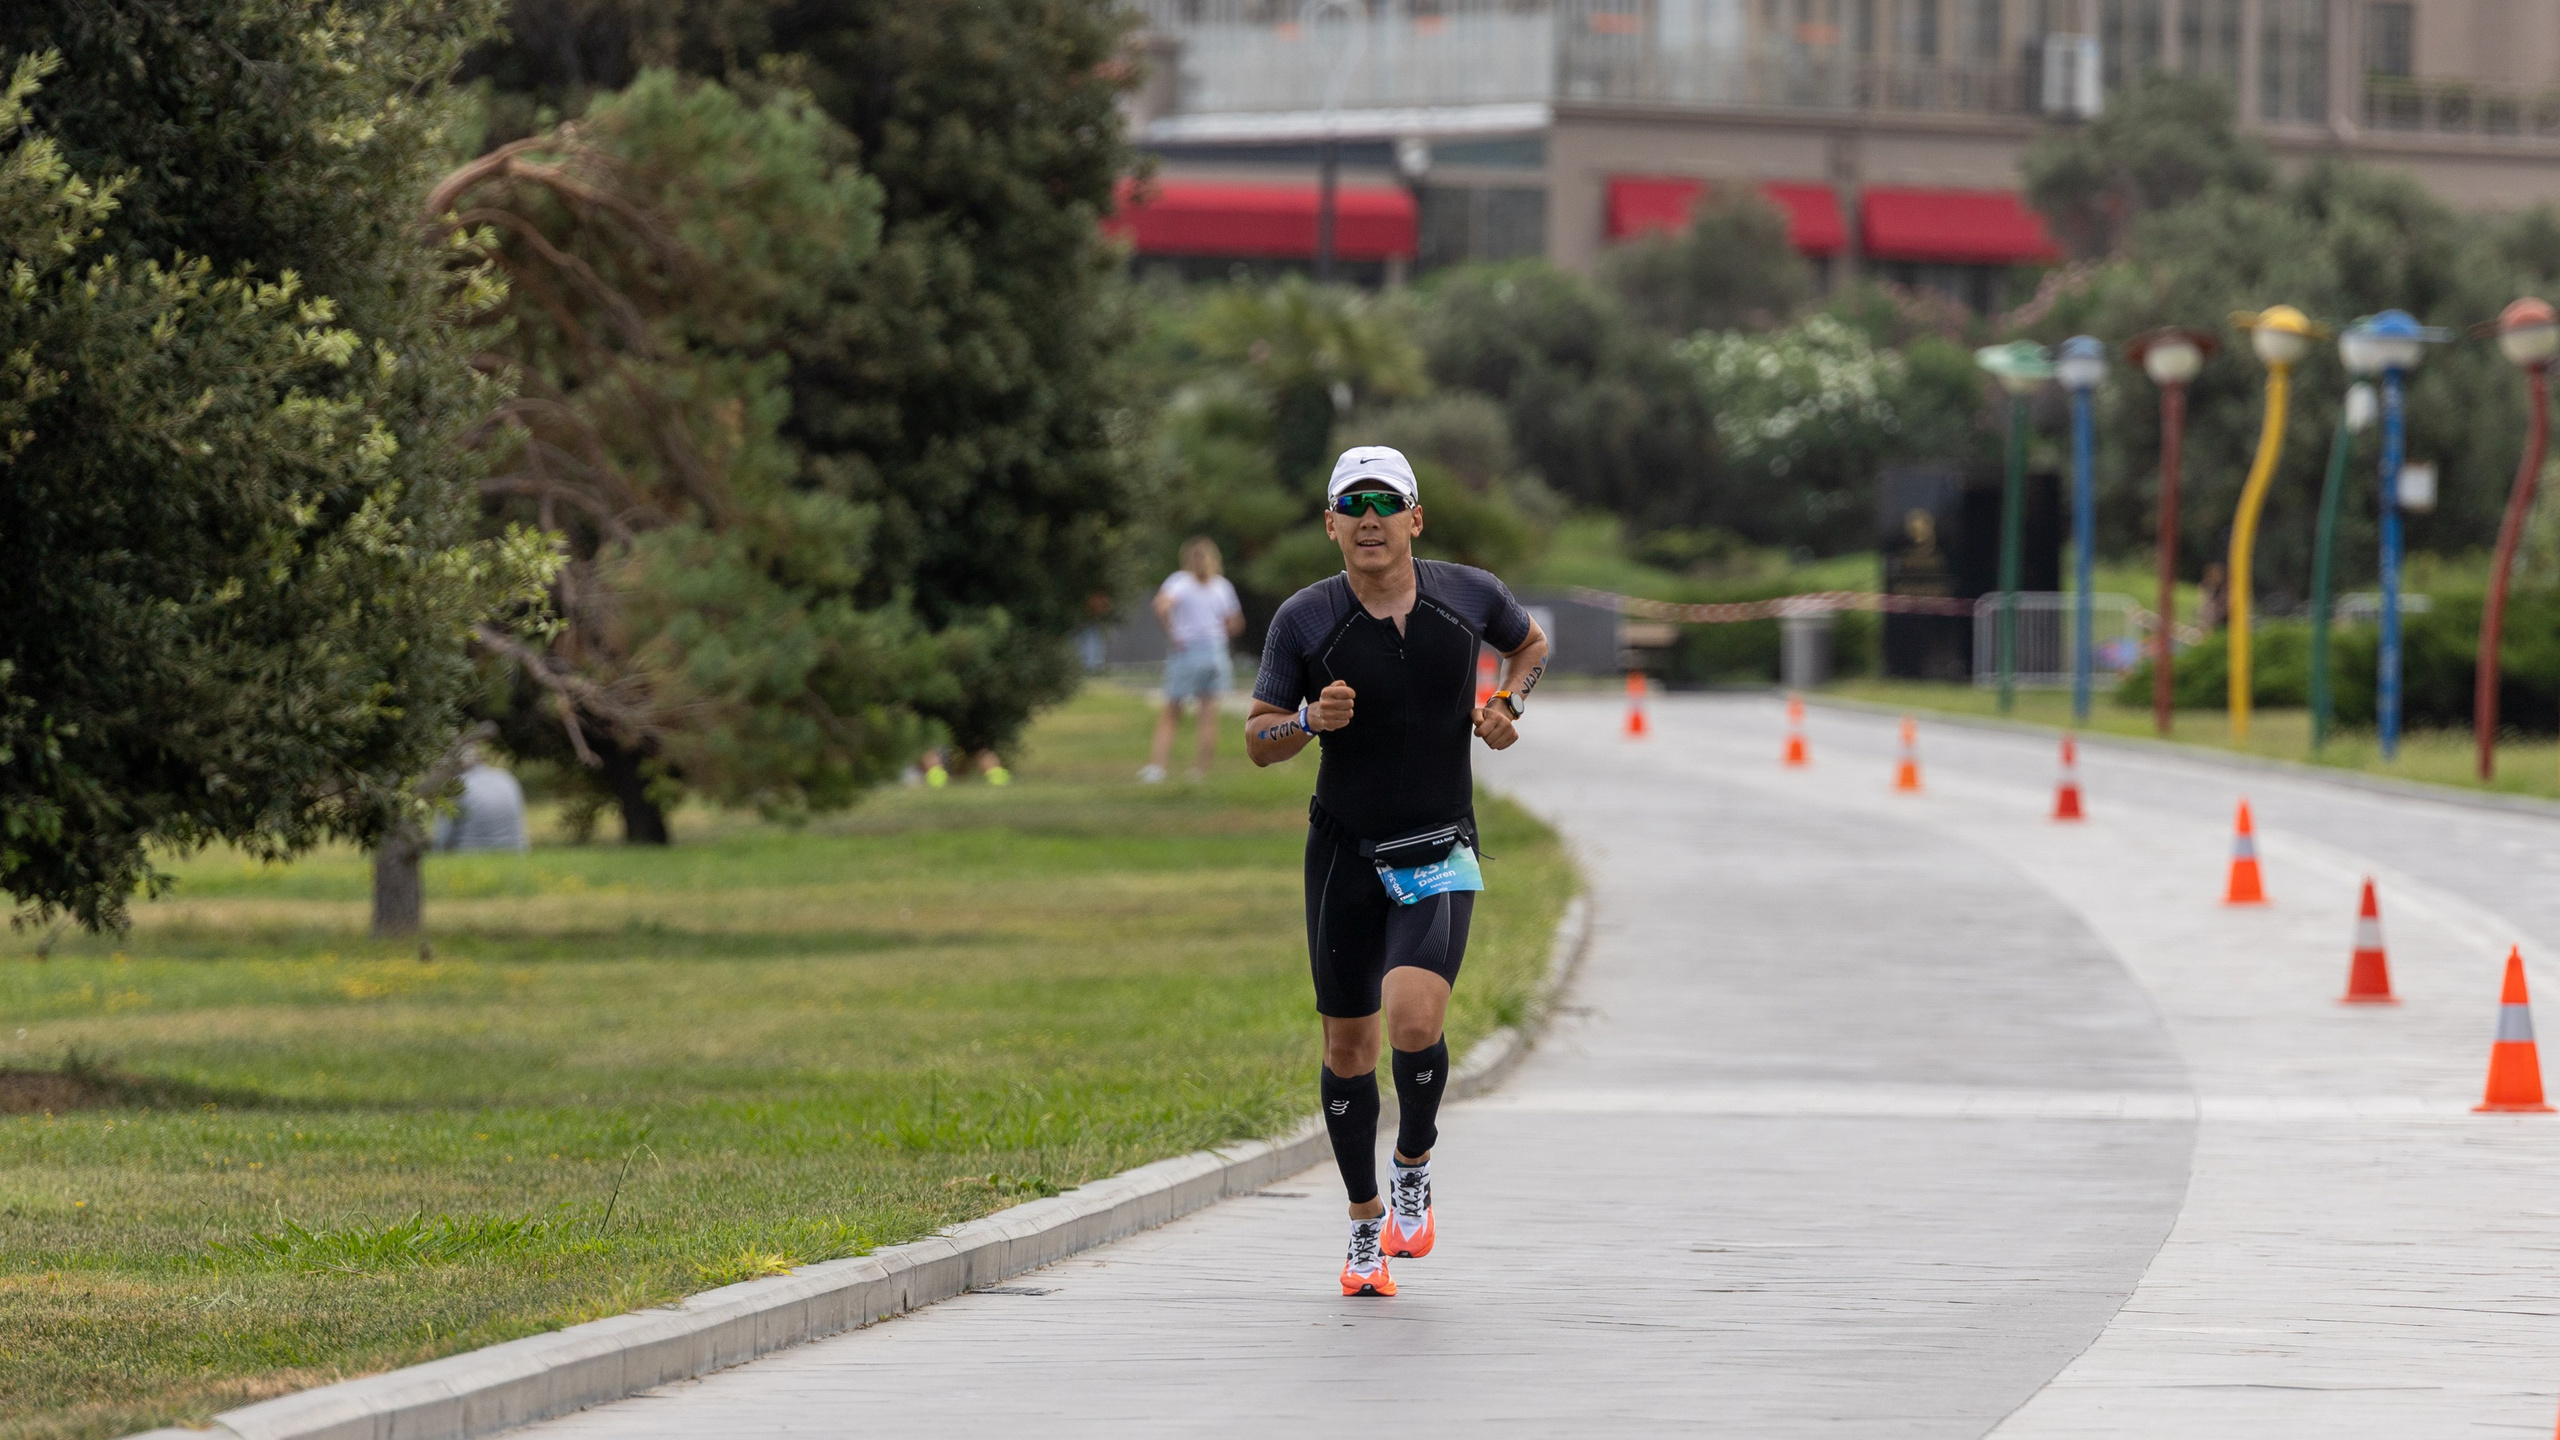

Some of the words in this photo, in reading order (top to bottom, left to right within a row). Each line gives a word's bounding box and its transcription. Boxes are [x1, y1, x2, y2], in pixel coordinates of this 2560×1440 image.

[1436, 607, 1459, 625] HUUB
[1520, 666, 1543, 694] 437
[1269, 720, 1300, 741] 437
[1418, 869, 1456, 887] Dauren
